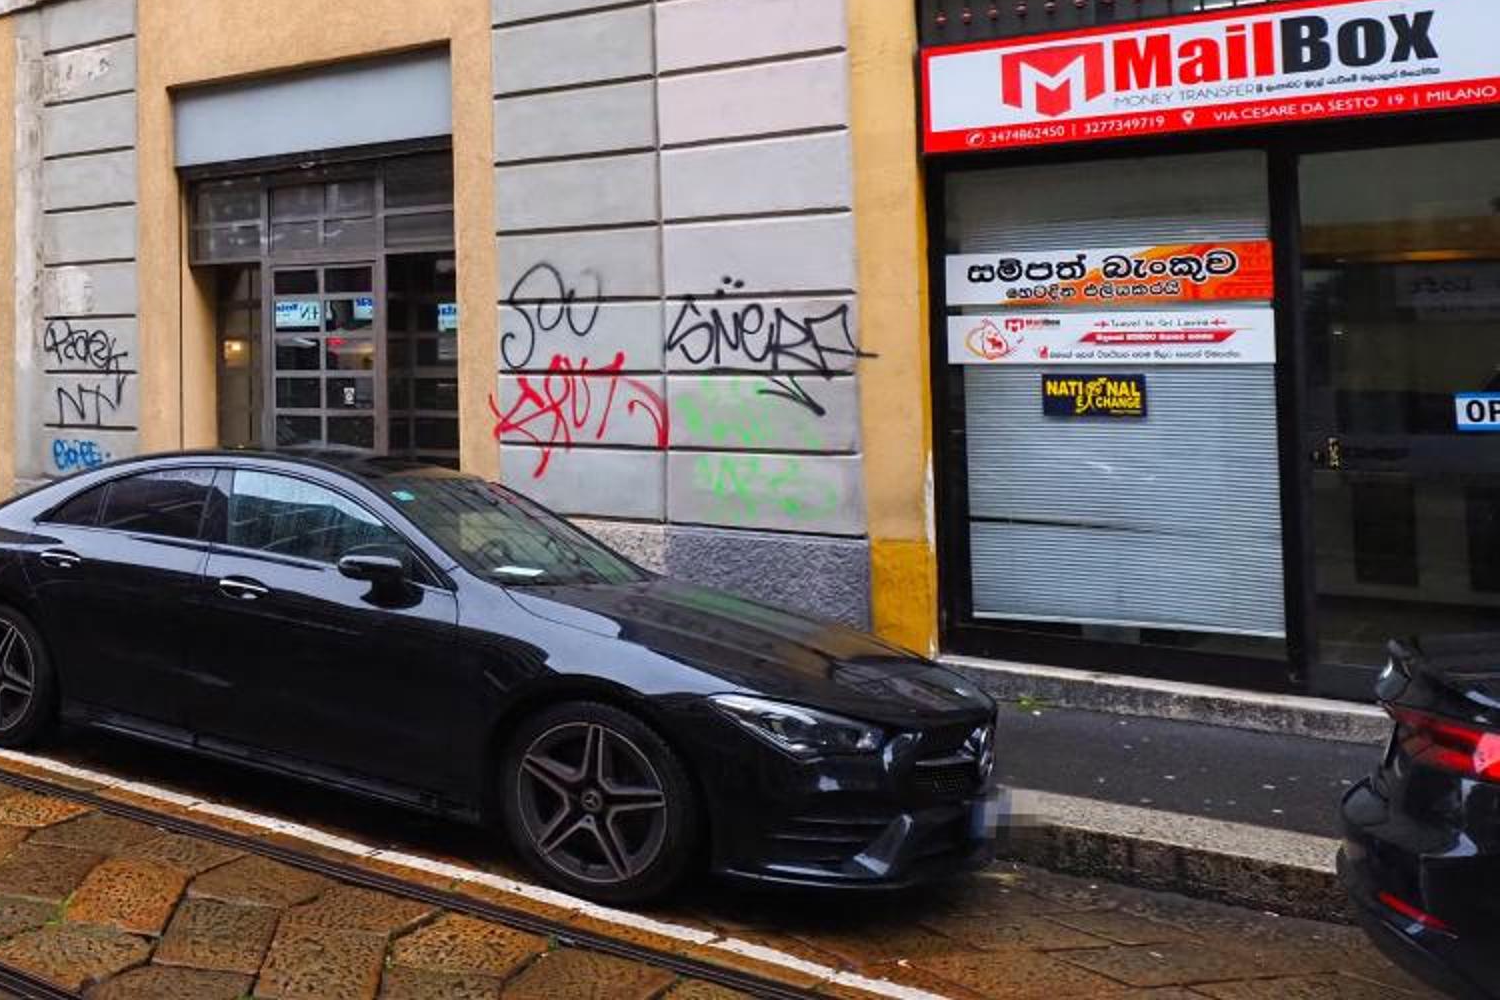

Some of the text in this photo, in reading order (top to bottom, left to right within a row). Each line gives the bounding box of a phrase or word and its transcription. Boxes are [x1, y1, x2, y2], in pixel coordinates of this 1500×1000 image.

[1114, 83, 1254, 108] MONEY TRANSFER
[1213, 110, 1239, 122] VIA
[1241, 103, 1297, 120] CESARE
[1301, 102, 1325, 114] DA
[1328, 95, 1379, 112] SESTO
[1387, 93, 1405, 106] 19
[1426, 85, 1497, 103] MILANO
